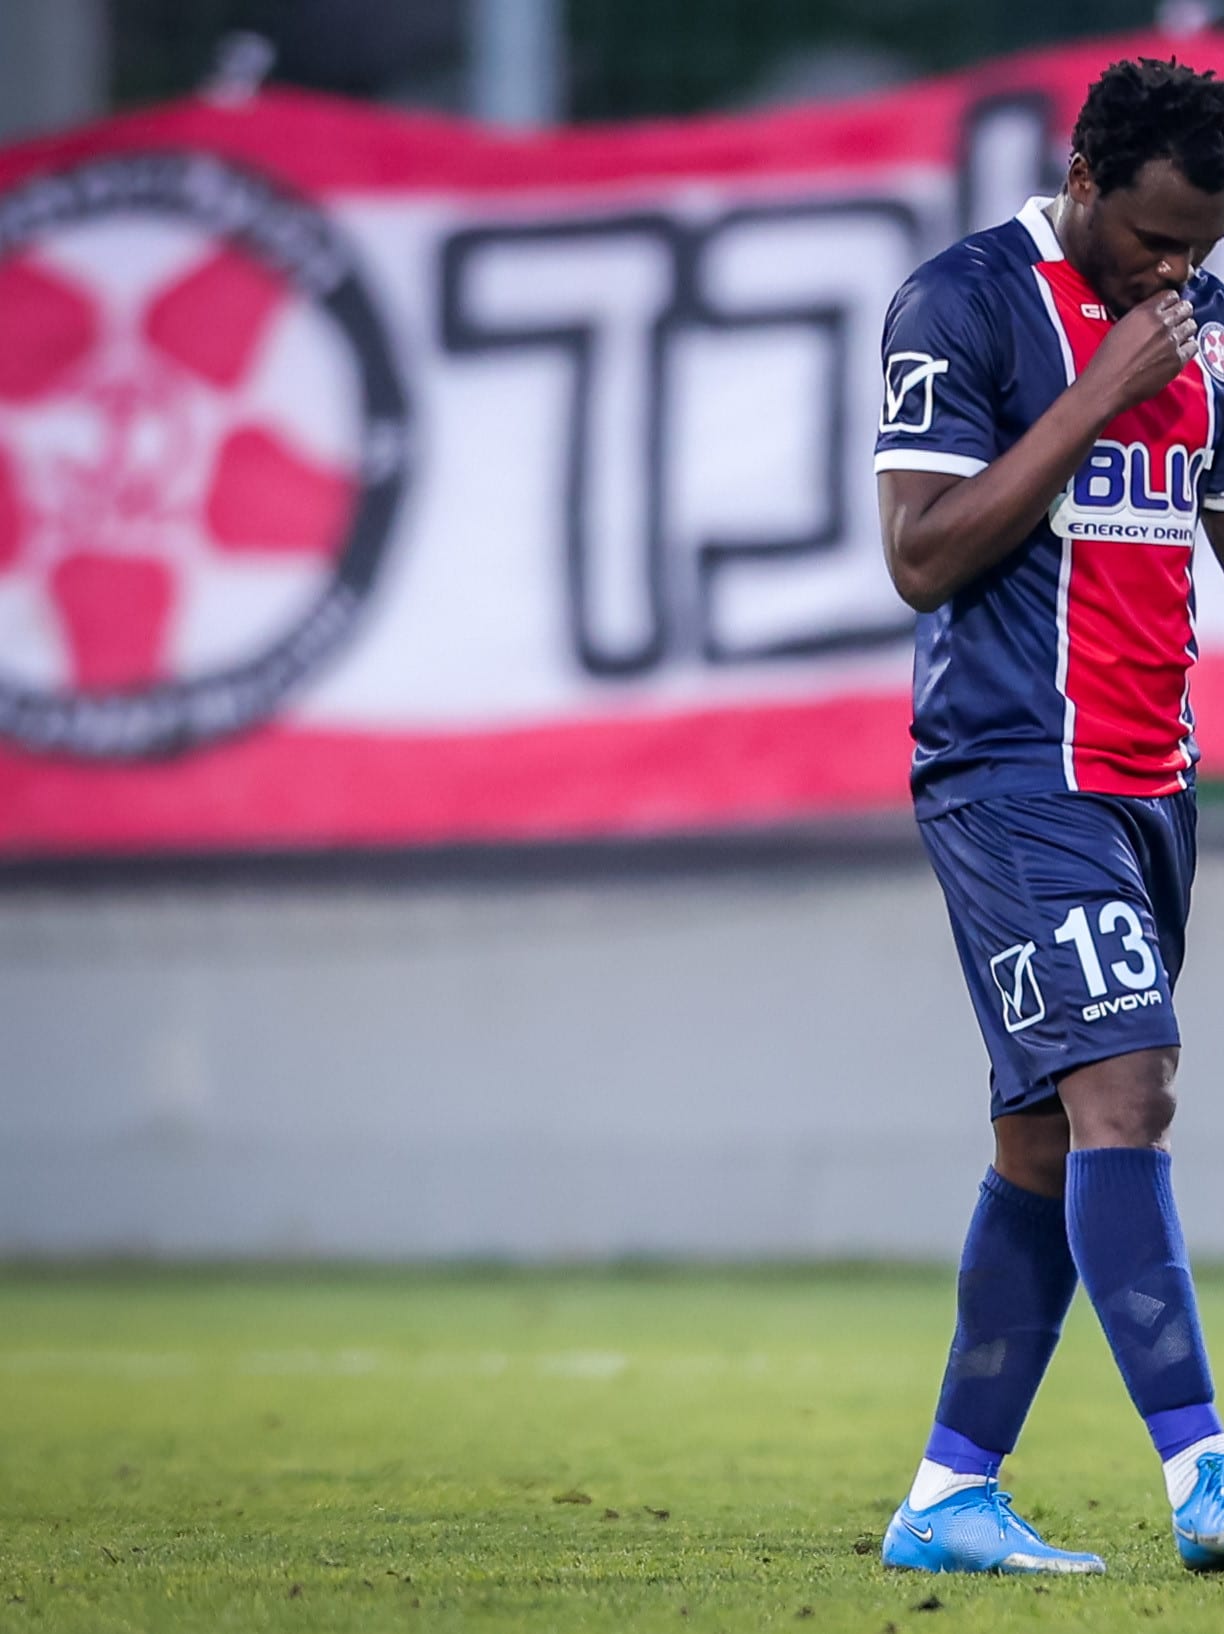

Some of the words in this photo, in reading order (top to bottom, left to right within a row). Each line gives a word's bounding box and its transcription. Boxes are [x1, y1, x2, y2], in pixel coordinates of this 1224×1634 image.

[1081, 303, 1108, 321] GI
[1068, 522, 1149, 540] ENERGY
[1154, 527, 1194, 540] DRIN
[1054, 901, 1156, 998] 13
[1082, 991, 1162, 1022] GIVOVA
